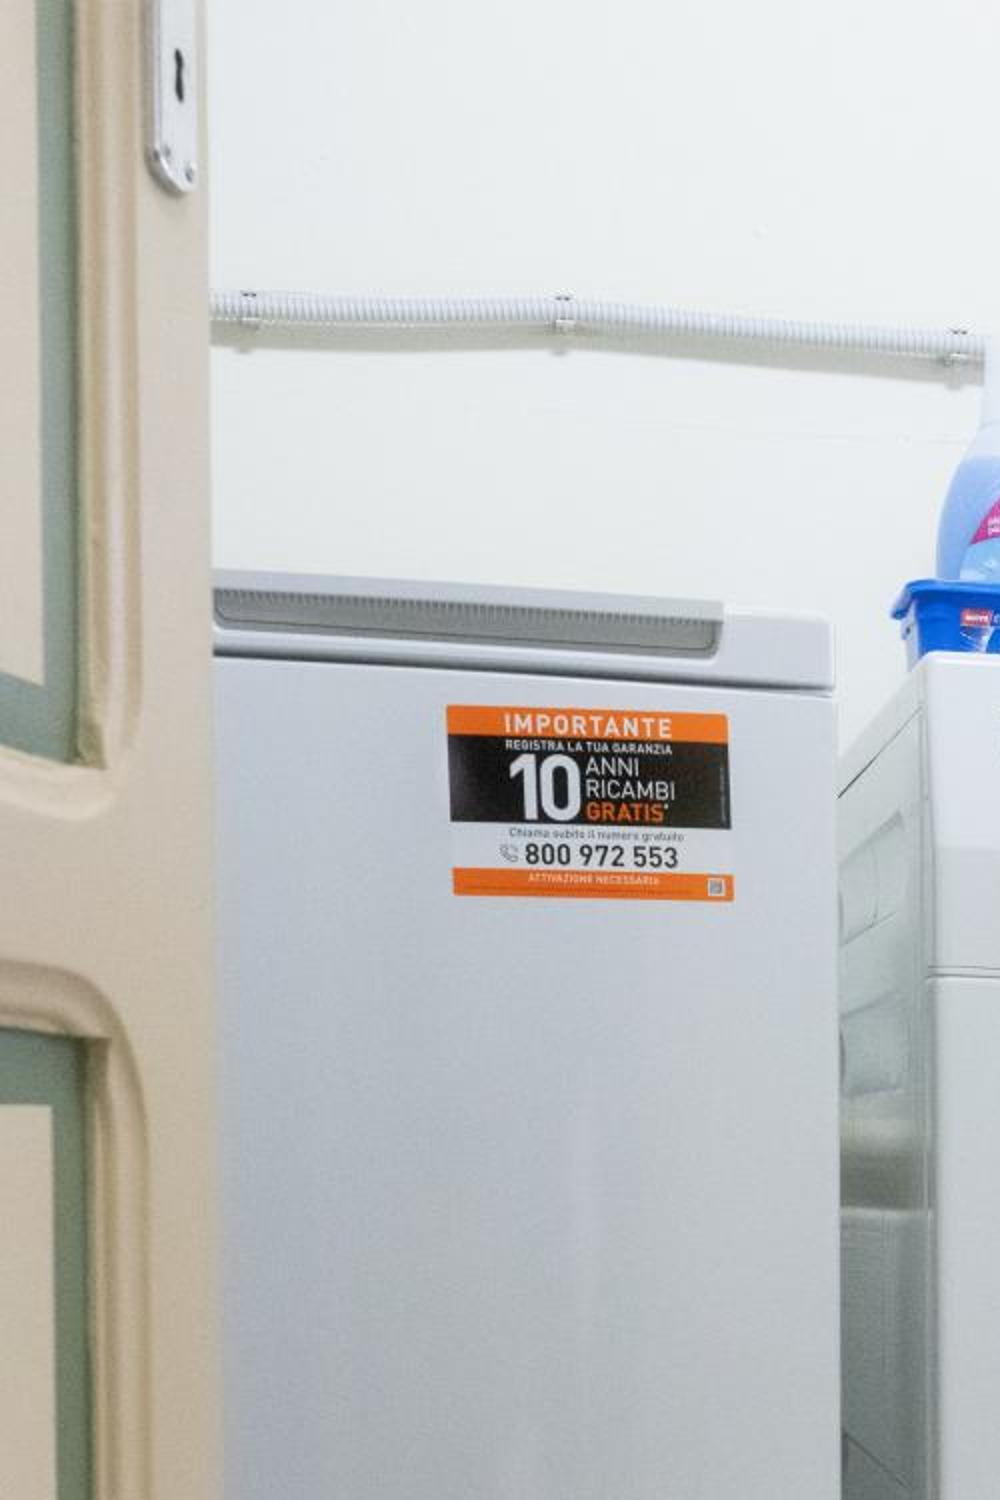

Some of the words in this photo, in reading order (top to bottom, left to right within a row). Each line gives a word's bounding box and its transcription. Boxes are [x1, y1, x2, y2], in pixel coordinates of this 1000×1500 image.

[503, 712, 673, 738] IMPORTANTE
[505, 739, 564, 751] REGISTRA
[567, 740, 583, 751] LA
[586, 741, 610, 753] TUA
[611, 743, 673, 755] GARANZIA
[586, 757, 639, 777] ANNI
[509, 753, 581, 821] 10
[586, 779, 675, 801] RICAMBI
[509, 827, 550, 839] Chiama
[552, 828, 585, 840] subito
[598, 831, 639, 841] numero
[642, 832, 685, 843] gratuito
[525, 843, 571, 865] 800
[579, 845, 625, 867] 972
[633, 847, 679, 869] 553
[528, 872, 594, 884] ATTIVAZIONE
[596, 874, 660, 886] NECESSARIA
